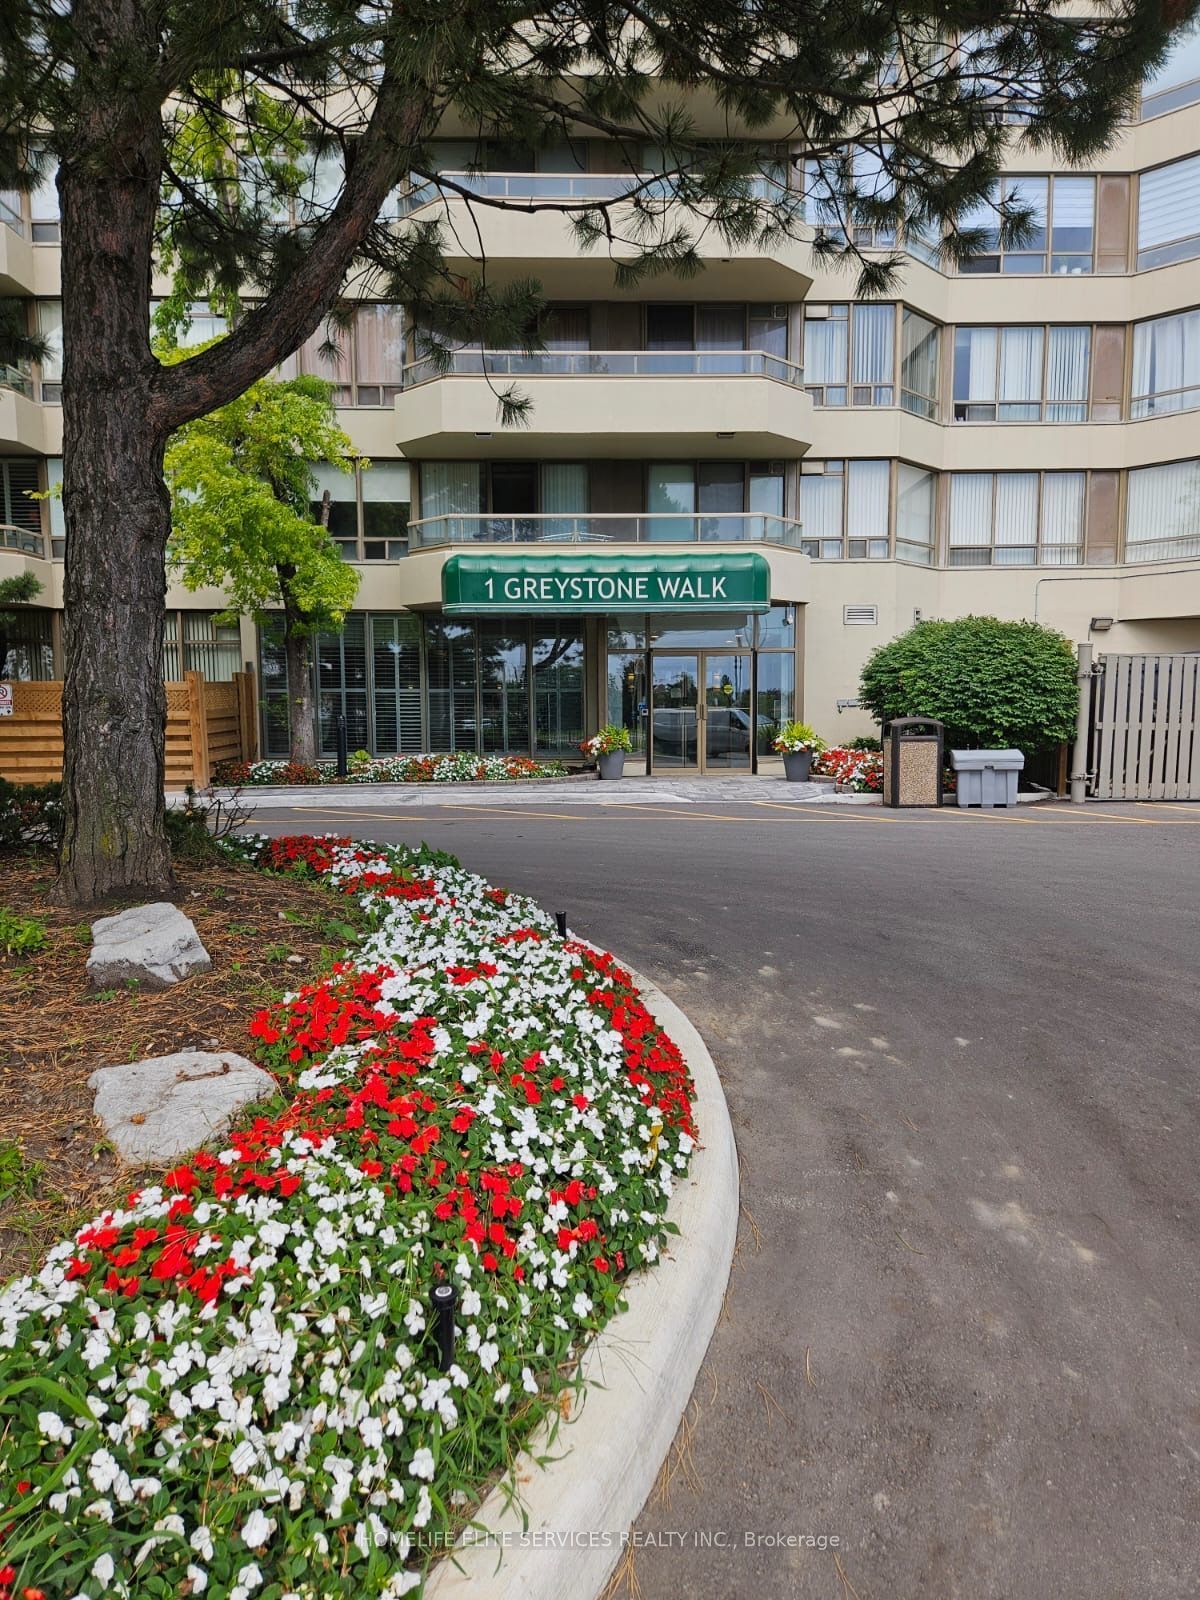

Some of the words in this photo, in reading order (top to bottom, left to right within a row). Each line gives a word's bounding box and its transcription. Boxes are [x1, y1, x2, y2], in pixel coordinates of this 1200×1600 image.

[484, 577, 494, 599] 1
[504, 576, 649, 600] GREYSTONE
[656, 576, 728, 599] WALK
